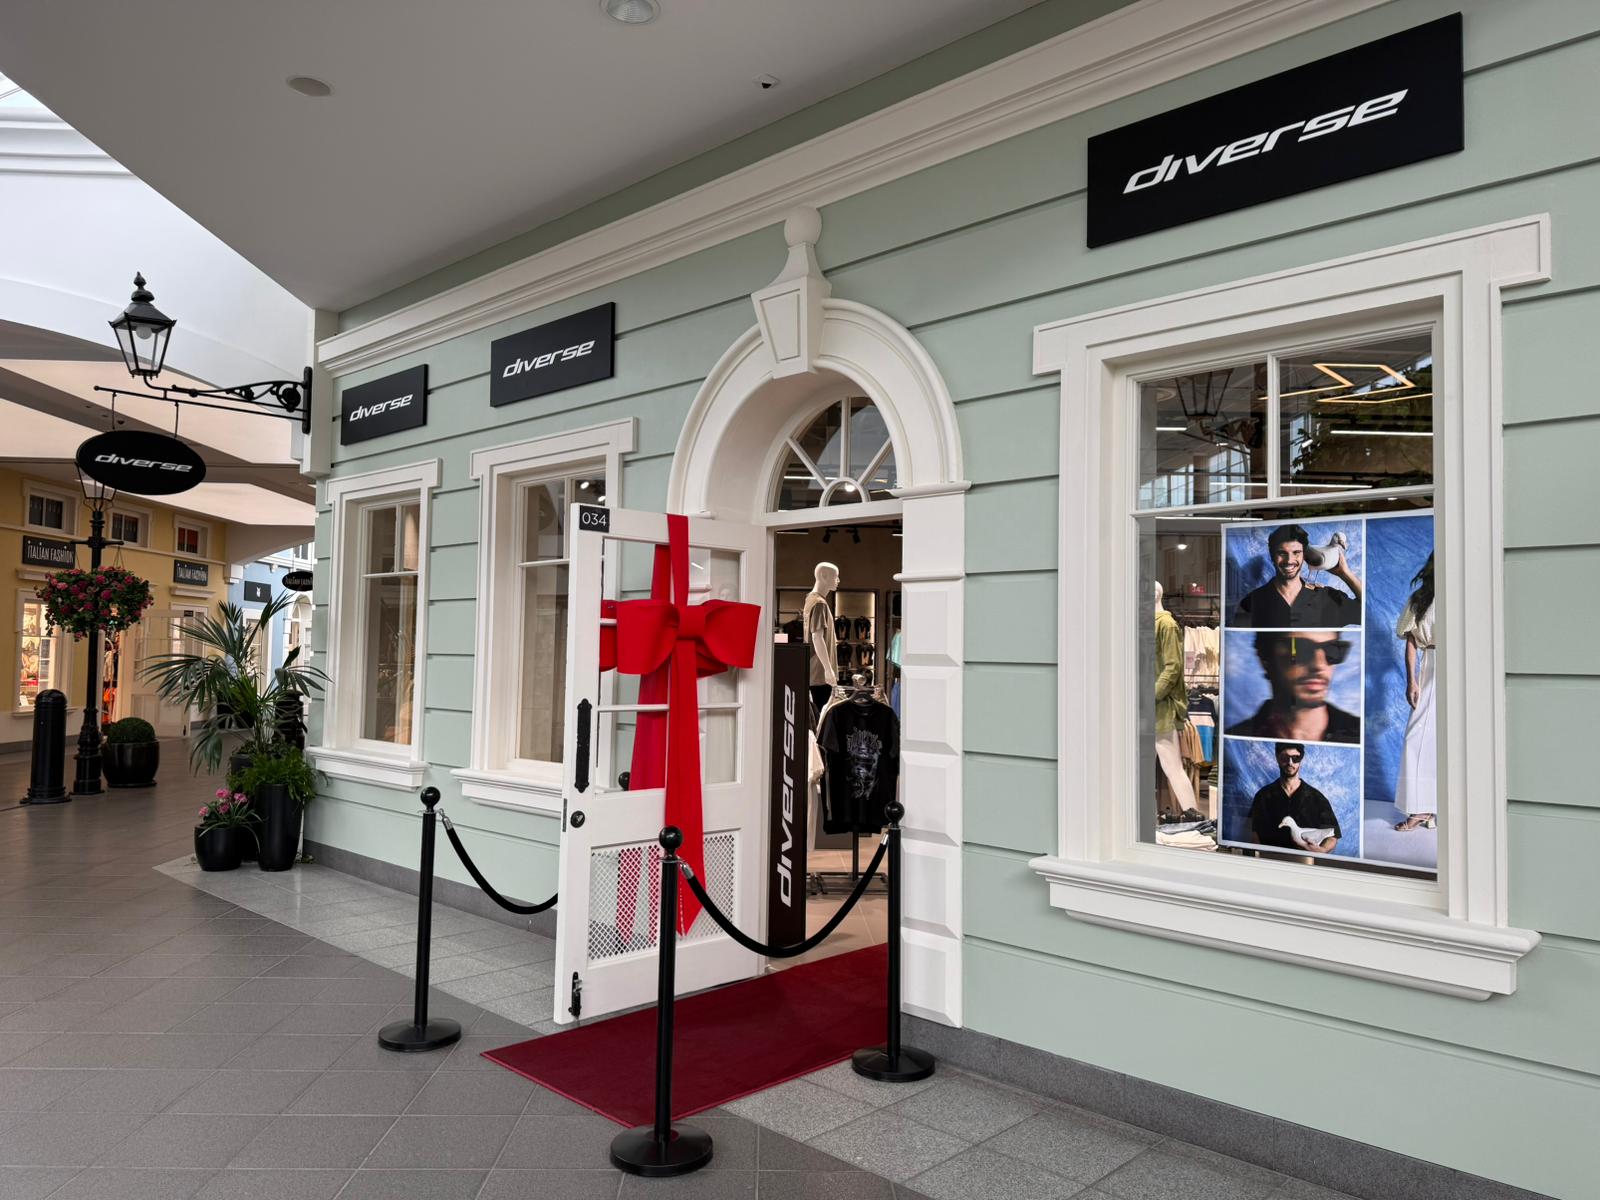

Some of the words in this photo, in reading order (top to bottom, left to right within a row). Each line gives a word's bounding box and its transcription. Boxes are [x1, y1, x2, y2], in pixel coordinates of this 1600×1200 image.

[1123, 88, 1409, 194] diverse
[502, 339, 596, 379] diverse
[349, 393, 414, 422] diverse
[94, 453, 193, 473] diverse
[582, 511, 607, 527] 034
[777, 684, 796, 907] diverse
